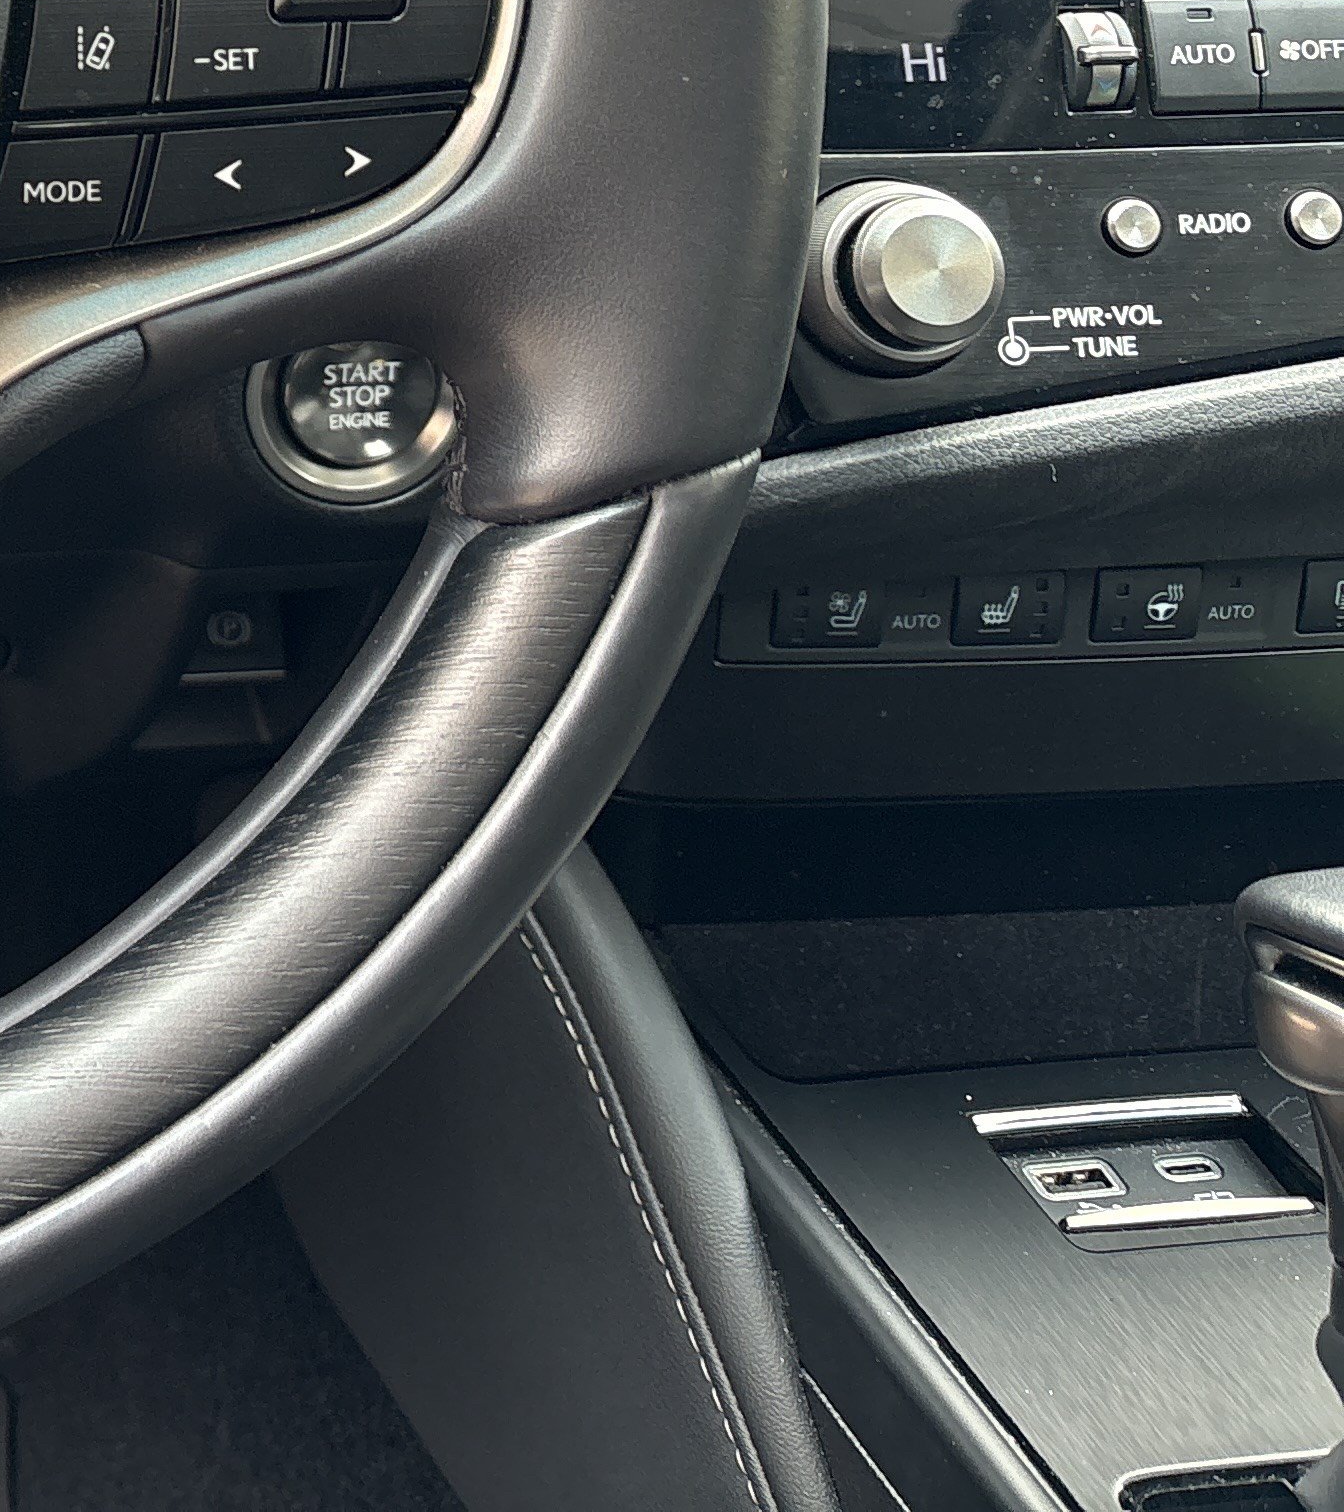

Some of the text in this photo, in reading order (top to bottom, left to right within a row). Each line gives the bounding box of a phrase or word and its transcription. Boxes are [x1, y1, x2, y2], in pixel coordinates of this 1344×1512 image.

[1170, 43, 1236, 66] AUTO
[1301, 38, 1344, 60] OFF
[900, 42, 948, 83] Hi
[22, 179, 103, 204] MODE
[1178, 211, 1252, 235] RADIO
[1072, 335, 1139, 358] TUNE
[323, 360, 403, 386] START
[328, 386, 392, 409] STOP
[328, 410, 392, 431] ENGINE
[892, 613, 942, 631] AUTO
[1207, 603, 1255, 621] AUTO
